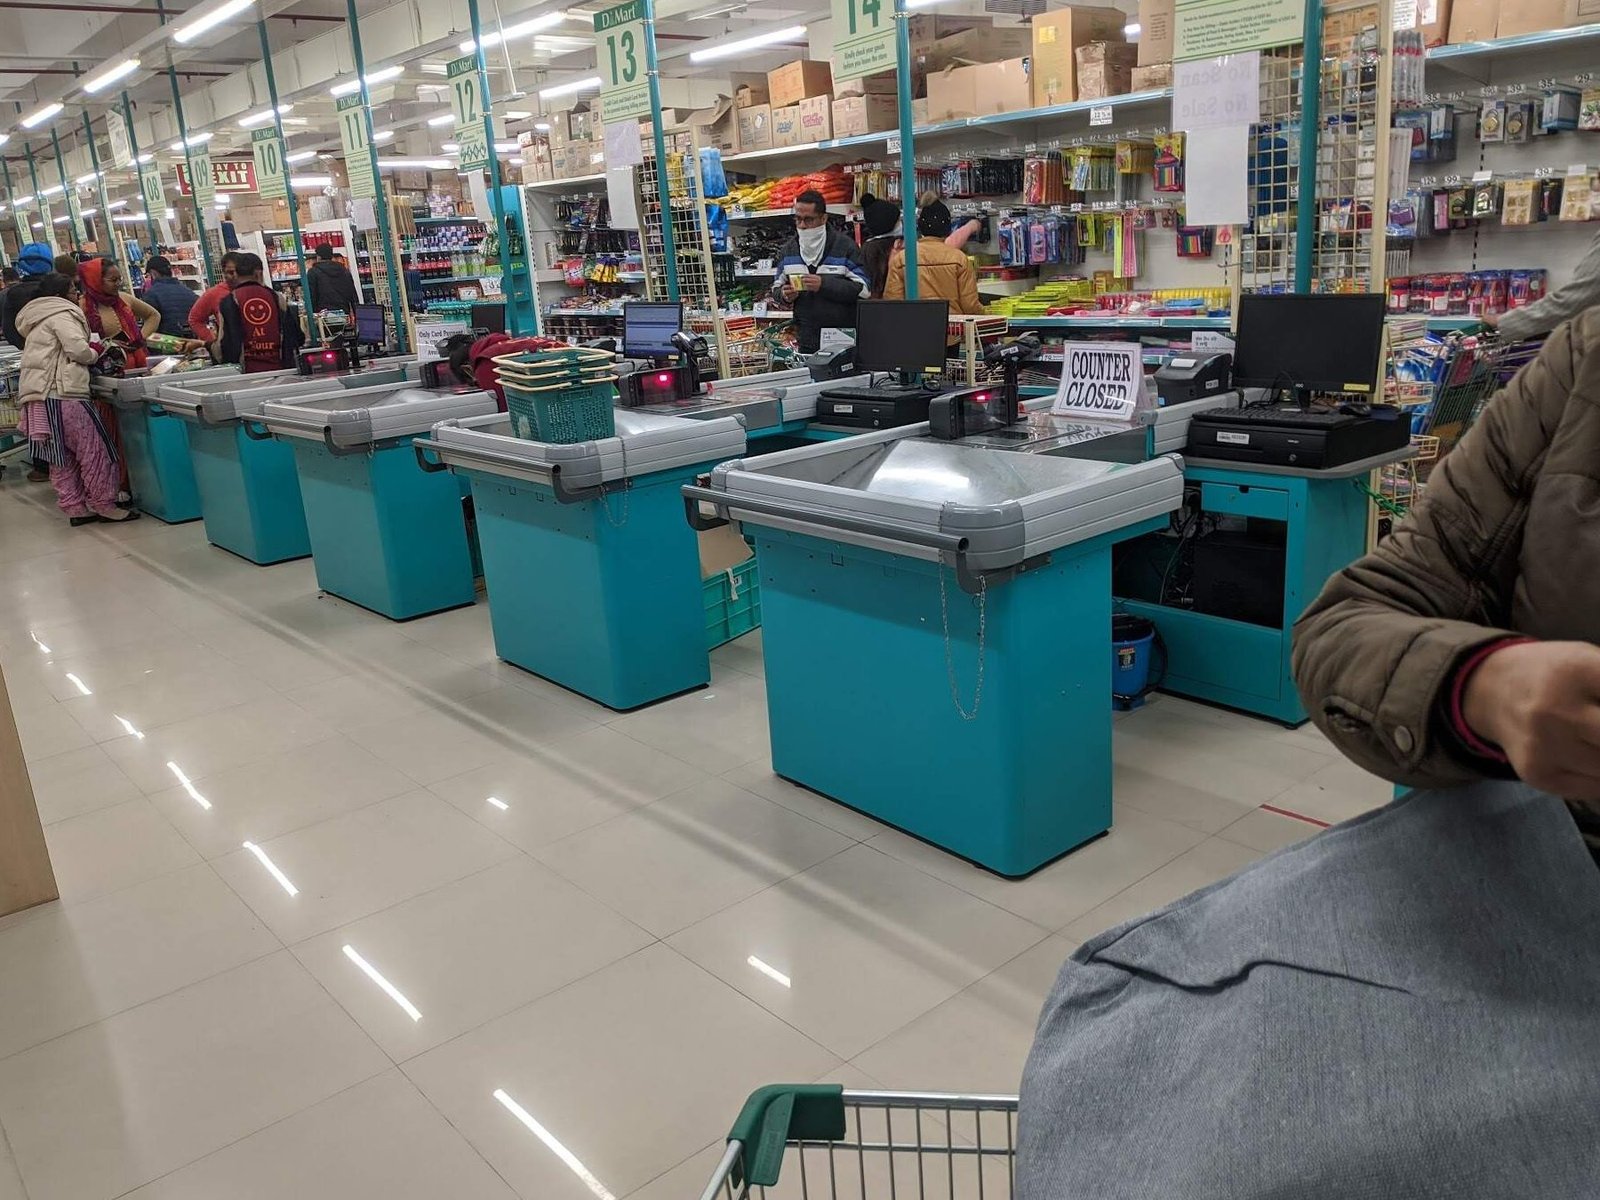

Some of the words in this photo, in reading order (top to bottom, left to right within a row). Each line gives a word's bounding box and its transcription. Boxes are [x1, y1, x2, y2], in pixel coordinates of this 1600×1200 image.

[607, 30, 637, 85] 13
[456, 79, 476, 123] 12
[345, 112, 363, 150] 11
[195, 159, 208, 187] 09
[234, 162, 247, 170] TO
[259, 143, 277, 176] 10
[146, 176, 160, 201] 08
[253, 327, 266, 337] At
[1071, 351, 1131, 382] COUNTER
[1066, 381, 1127, 411] CLOSED
